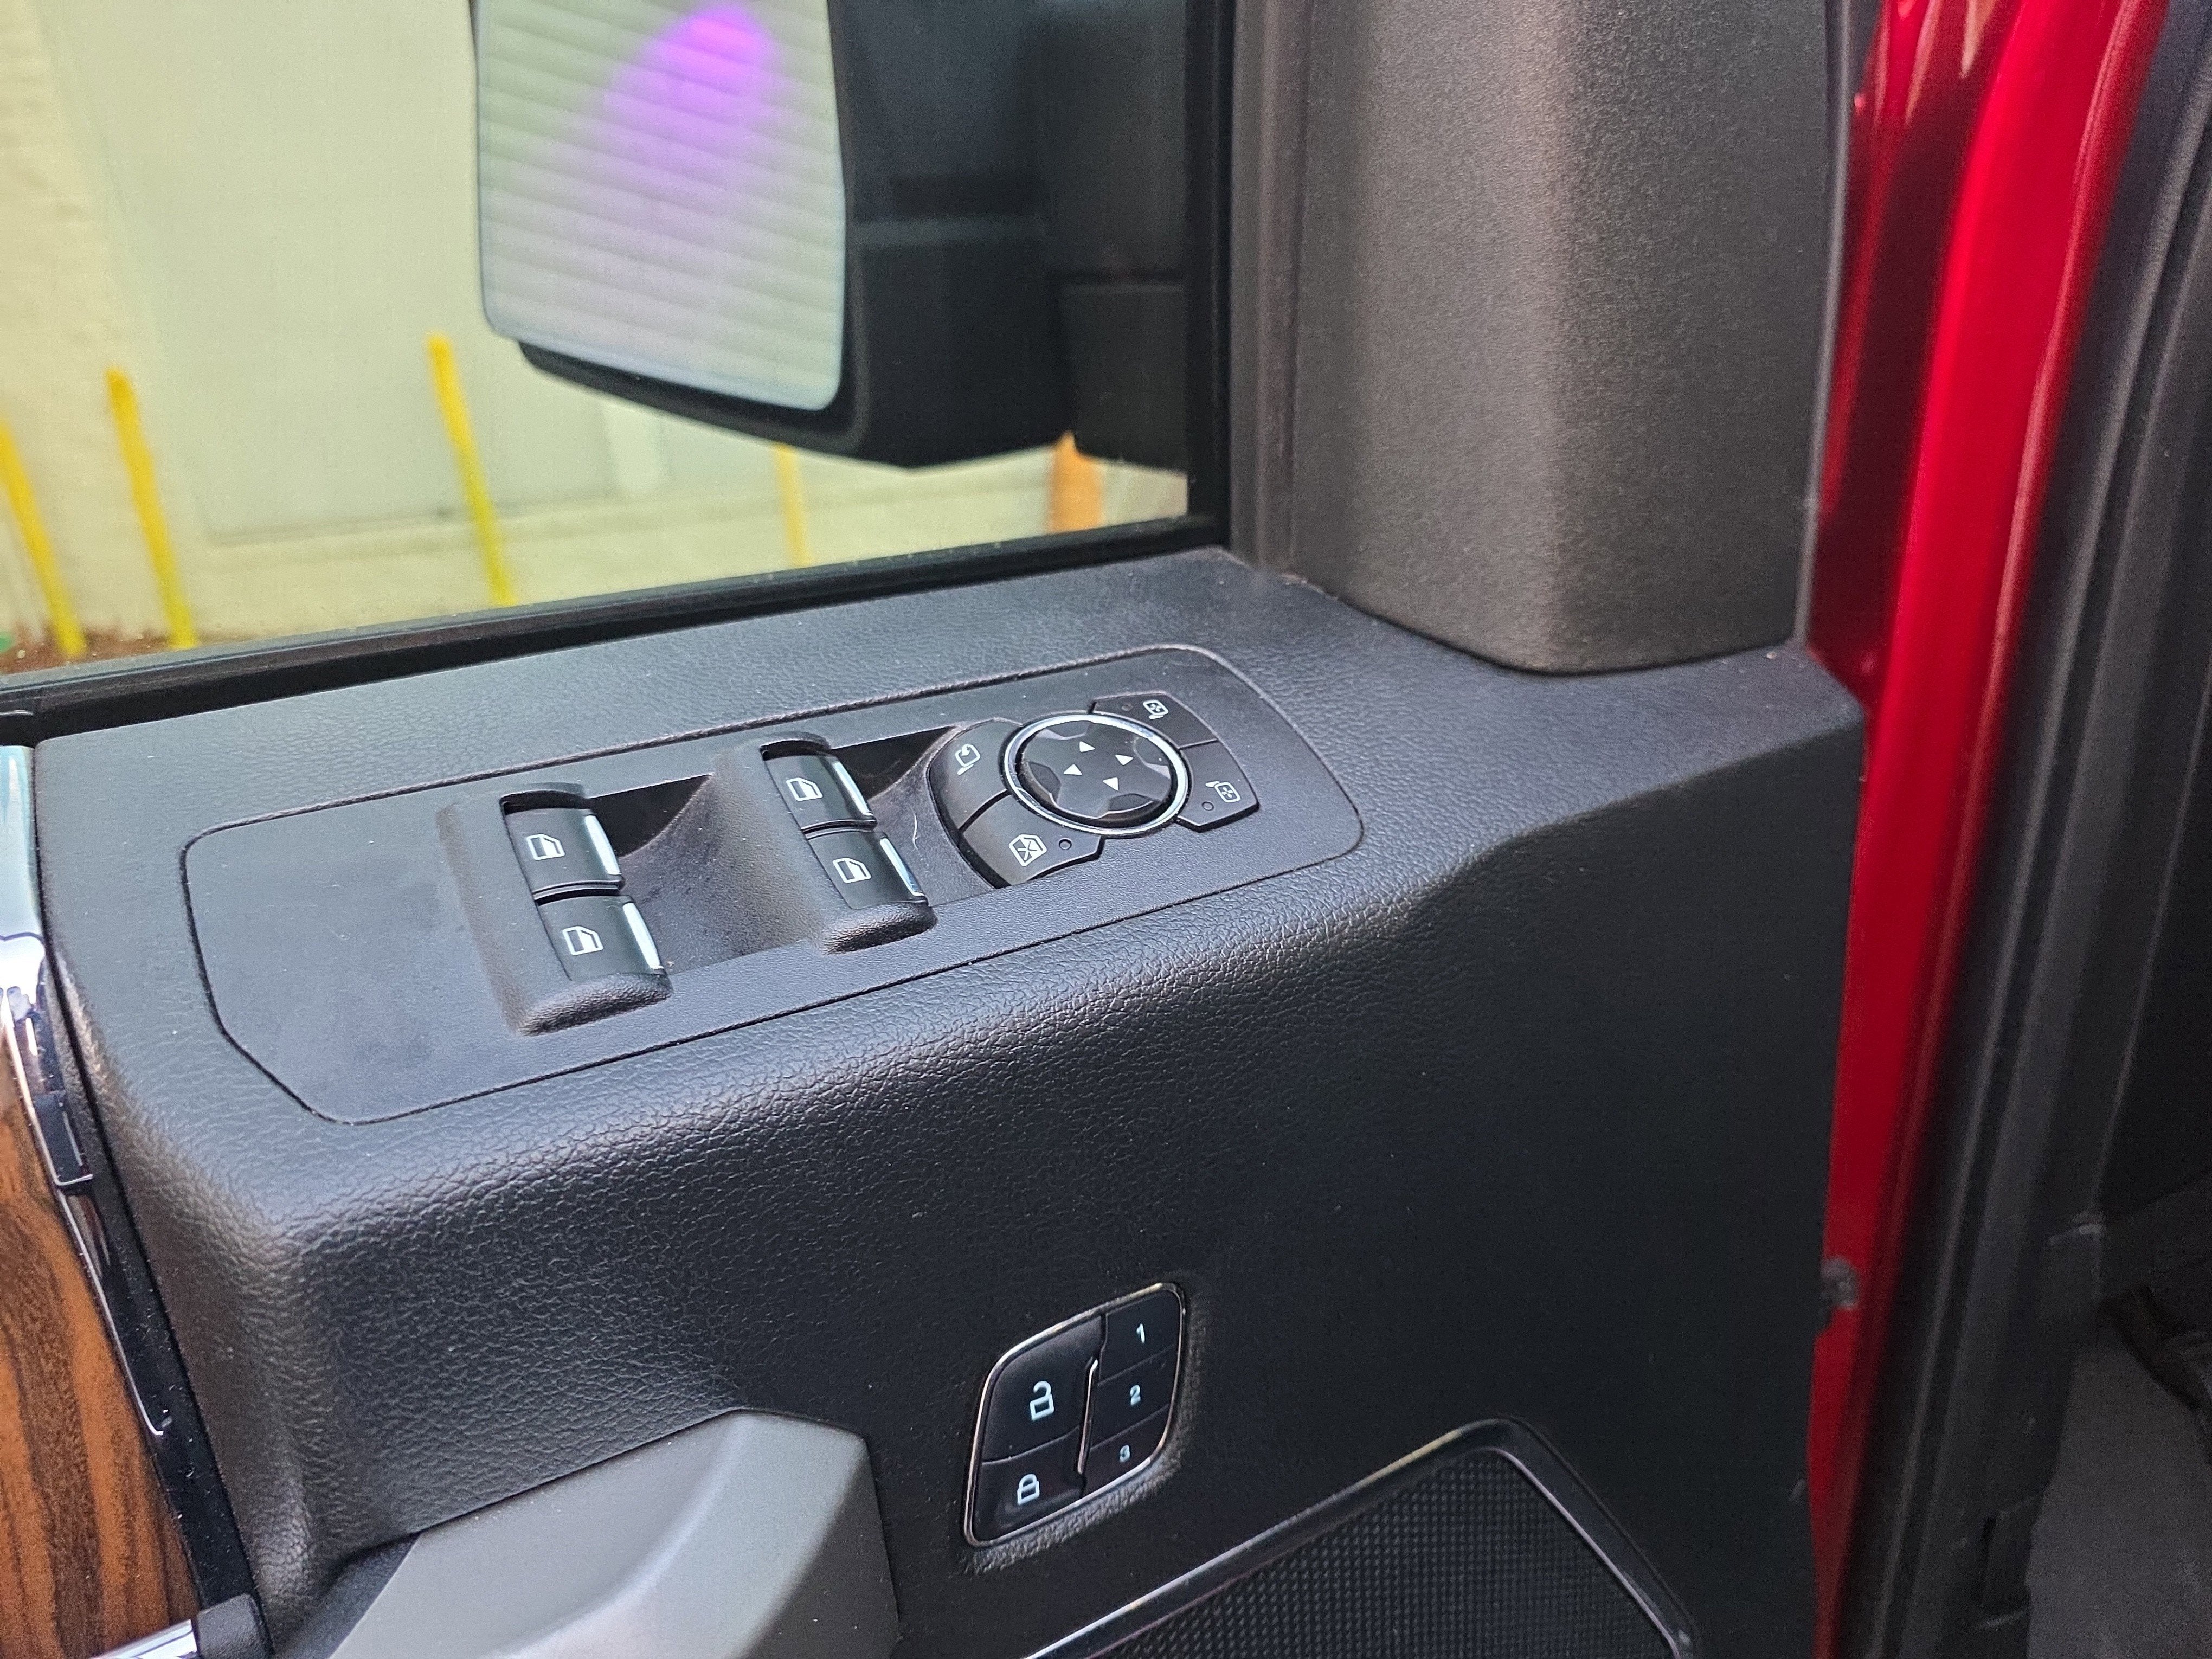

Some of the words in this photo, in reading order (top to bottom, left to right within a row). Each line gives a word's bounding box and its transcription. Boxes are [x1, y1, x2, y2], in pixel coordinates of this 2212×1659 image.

[1136, 1323, 1145, 1343] 1
[1130, 1384, 1141, 1405] 2
[1119, 1445, 1130, 1463] 3
